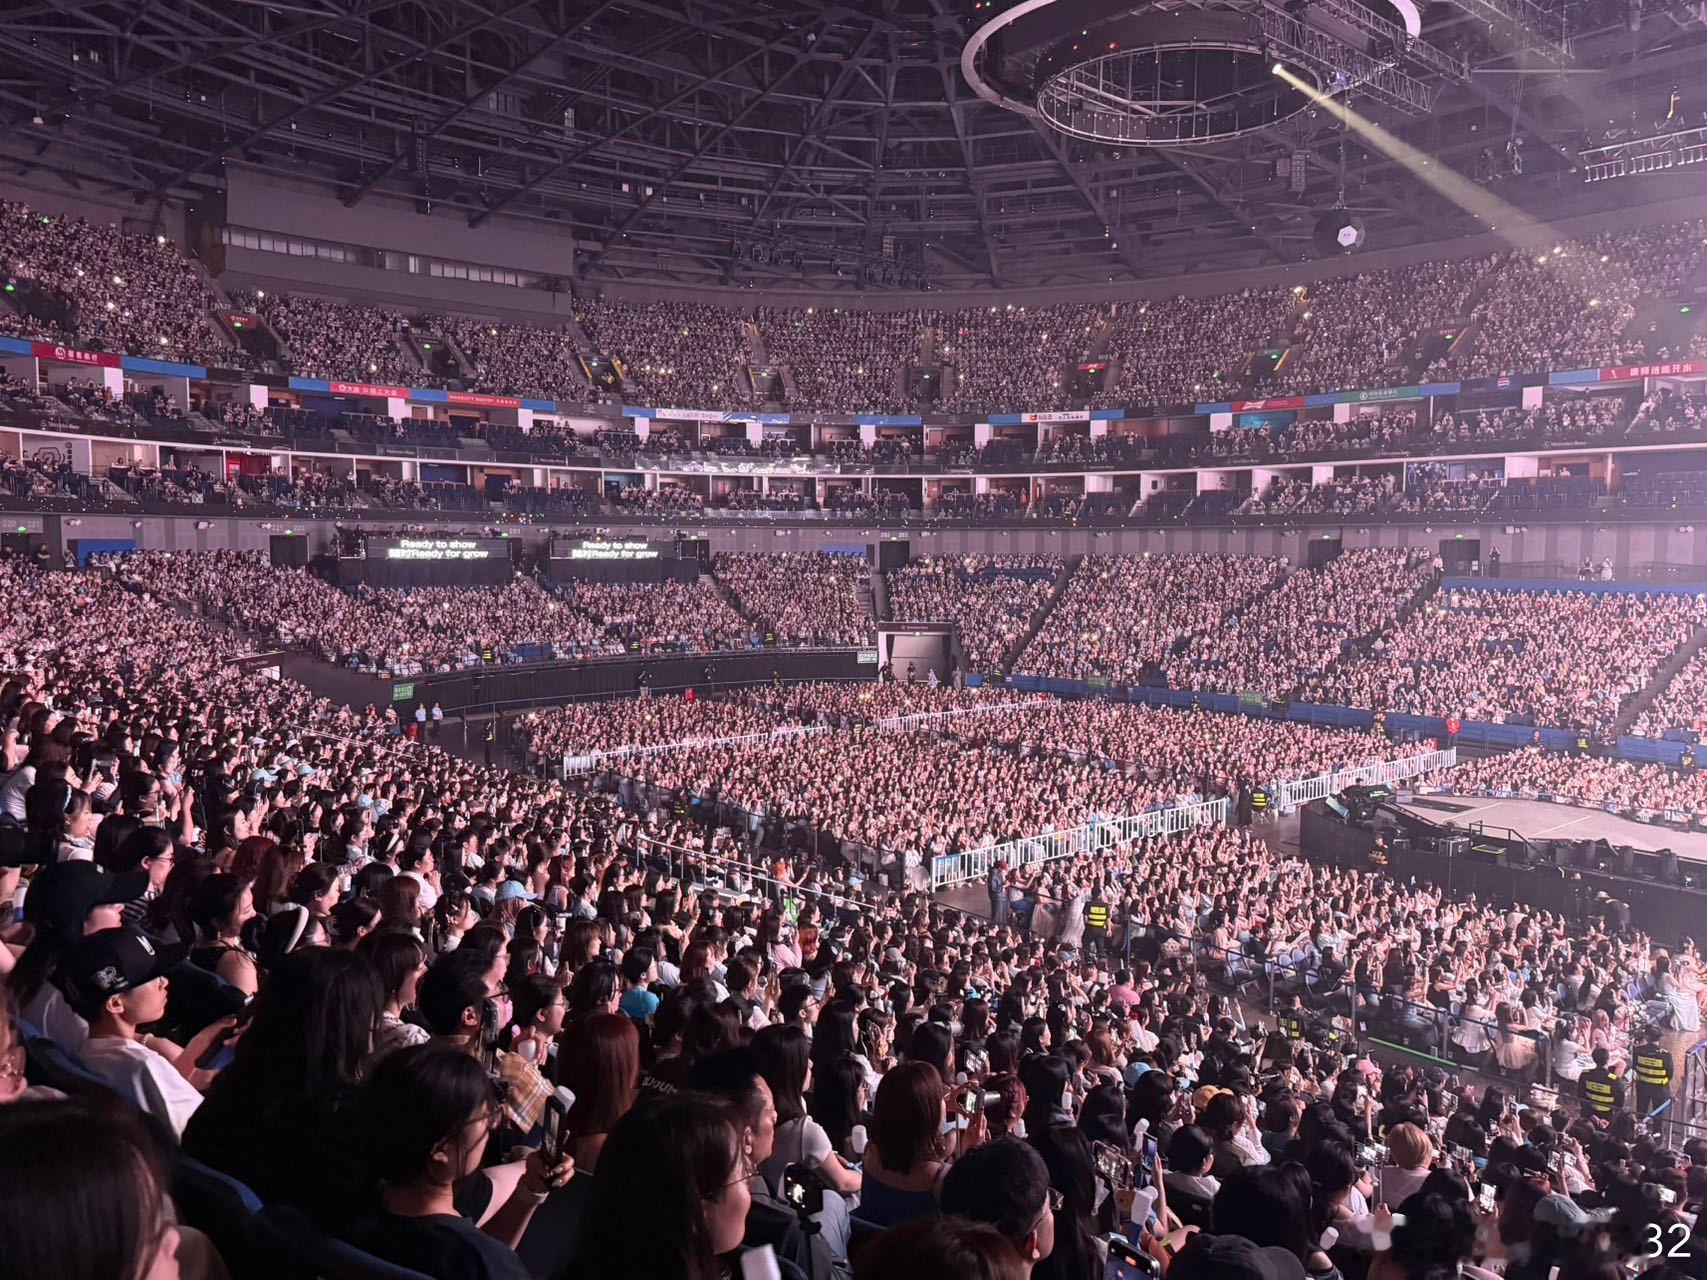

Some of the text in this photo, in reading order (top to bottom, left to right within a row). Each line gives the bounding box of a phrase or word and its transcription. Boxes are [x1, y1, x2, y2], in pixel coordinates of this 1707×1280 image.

[401, 540, 476, 549] Ready to show
[582, 542, 611, 550] Ready
[445, 549, 461, 557] for
[463, 550, 489, 558] grow
[636, 551, 658, 559] grow
